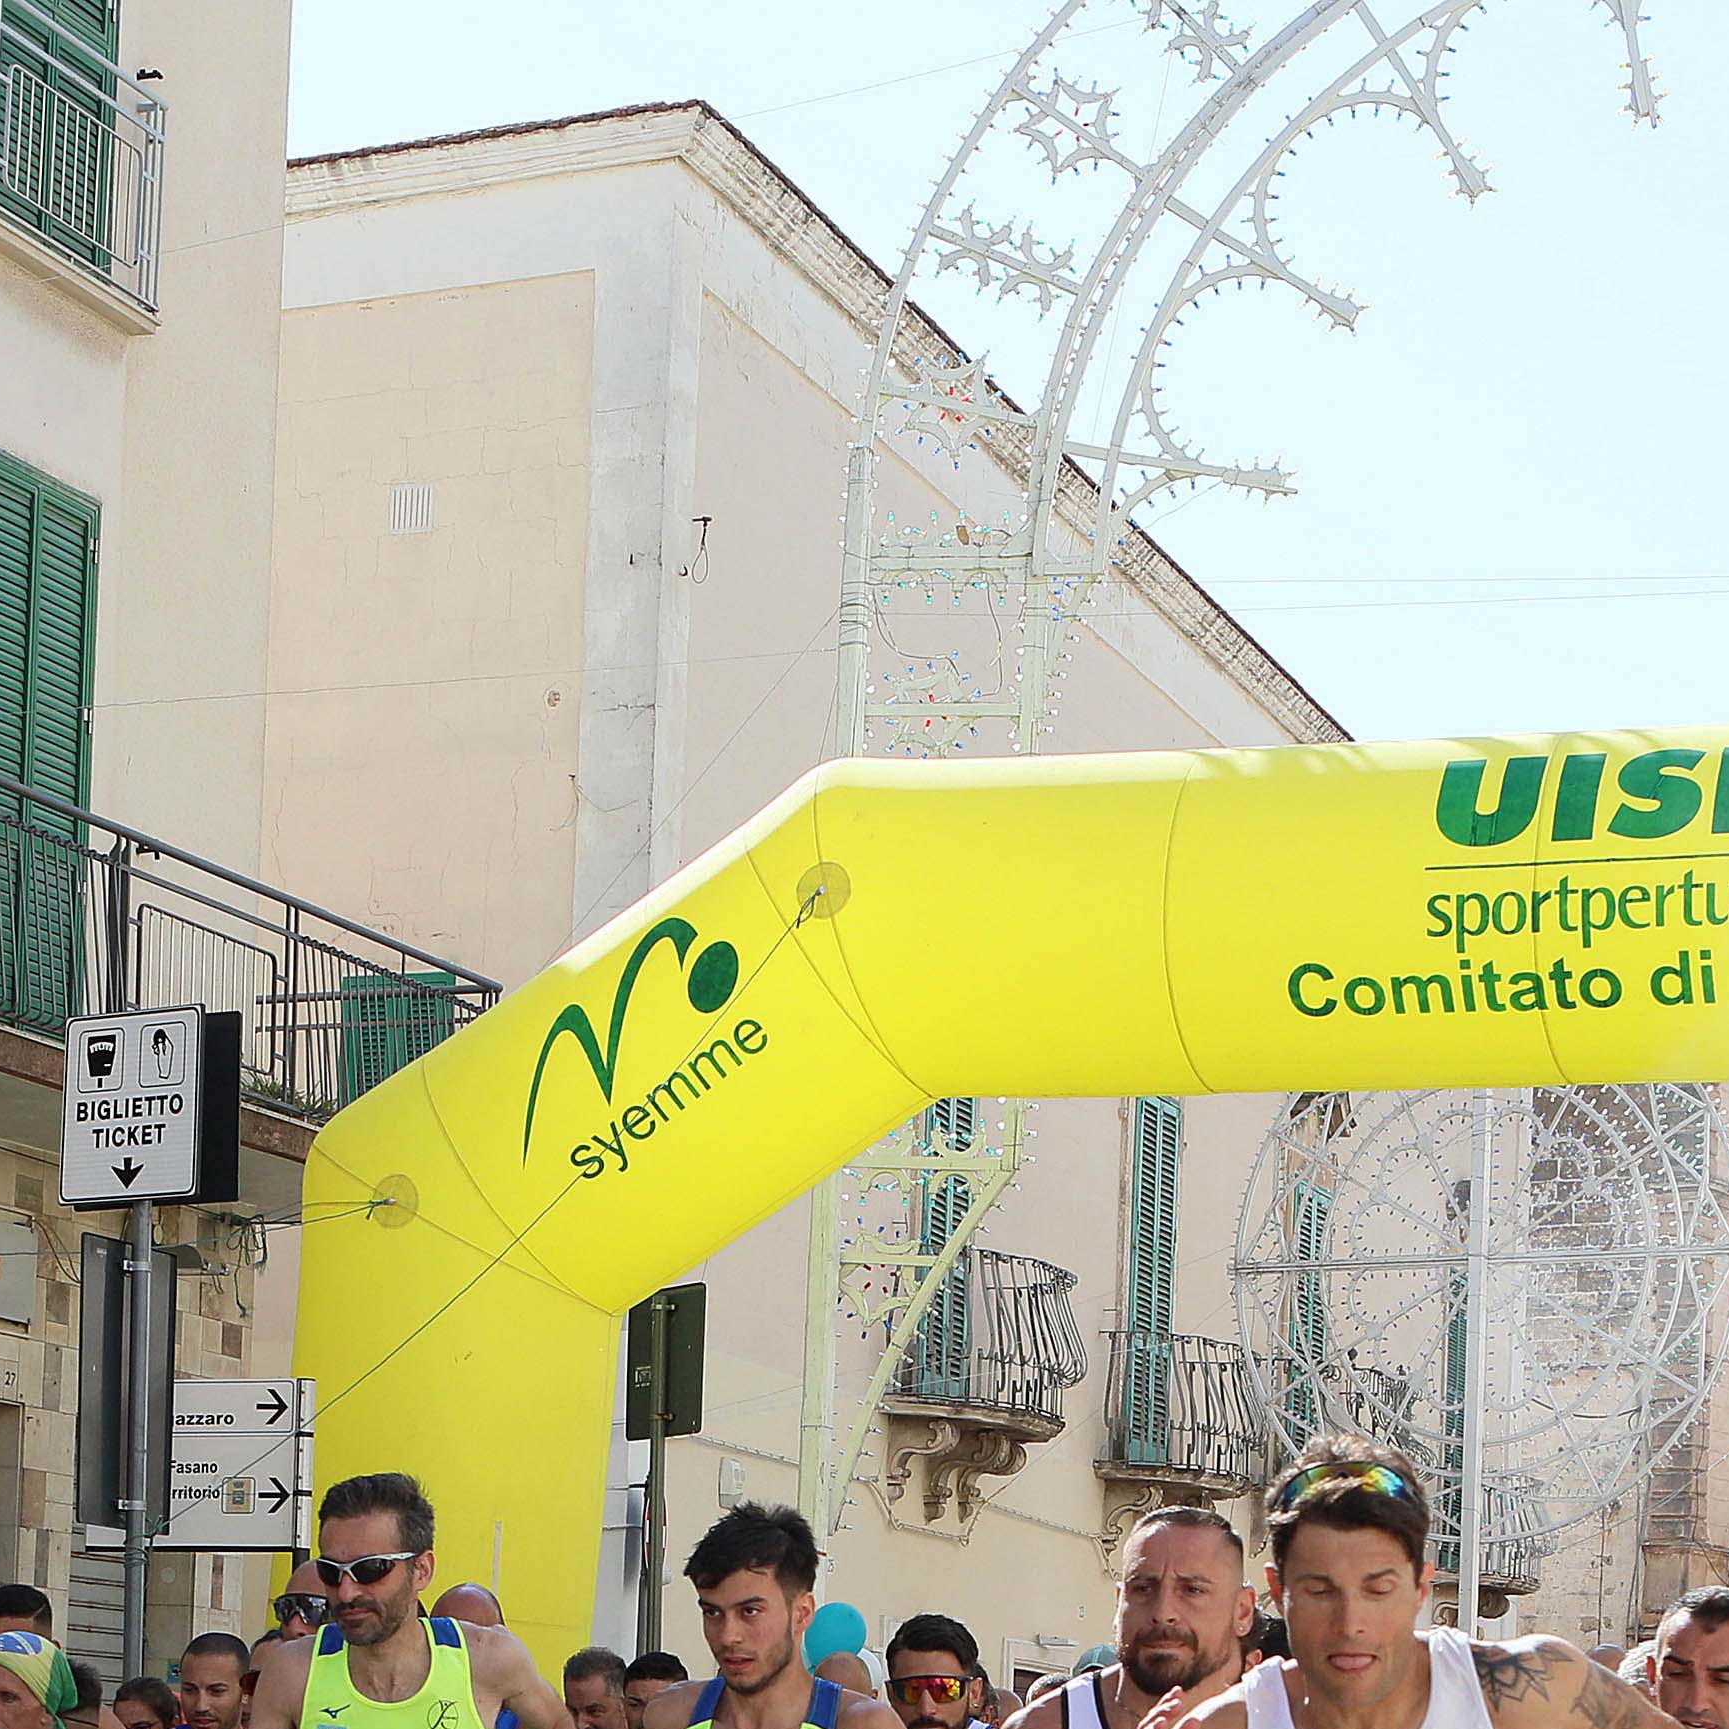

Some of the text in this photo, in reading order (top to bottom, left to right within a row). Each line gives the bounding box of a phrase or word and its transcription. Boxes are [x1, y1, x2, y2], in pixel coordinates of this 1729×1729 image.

[1287, 957, 1623, 1018] Comitato
[1650, 950, 1715, 1004] di
[76, 1093, 183, 1122] BIGLIETTO
[570, 1019, 769, 1179] syemme
[92, 1124, 166, 1148] TICKET
[4, 1371, 17, 1386] 27
[173, 1413, 234, 1426] azzaro
[171, 1484, 220, 1499] rritorio
